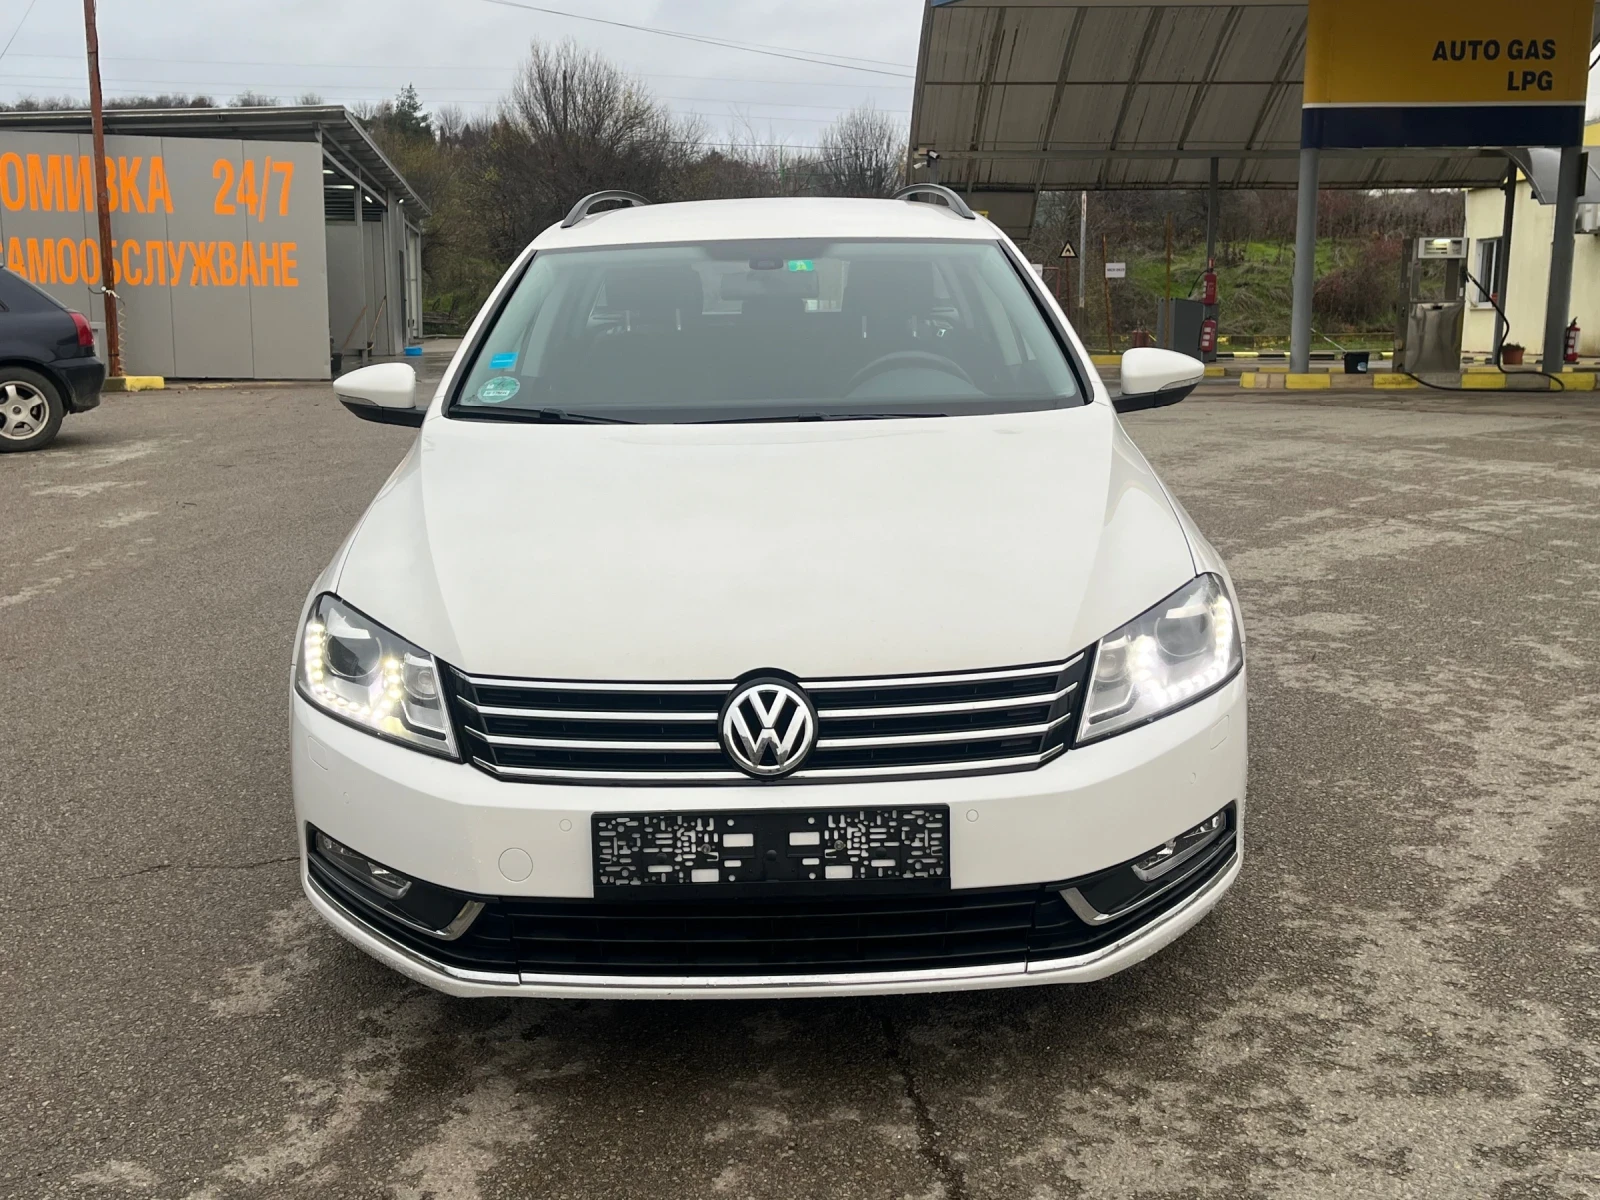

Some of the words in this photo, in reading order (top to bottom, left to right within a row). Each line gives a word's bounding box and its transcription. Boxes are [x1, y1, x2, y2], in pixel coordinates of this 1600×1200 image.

[1432, 40, 1500, 62] AUTO
[1507, 39, 1556, 61] GAS
[1507, 71, 1553, 92] LPG
[212, 157, 295, 222] 24/7
[0, 237, 299, 287] АМООСЛУЖВАНЕ
